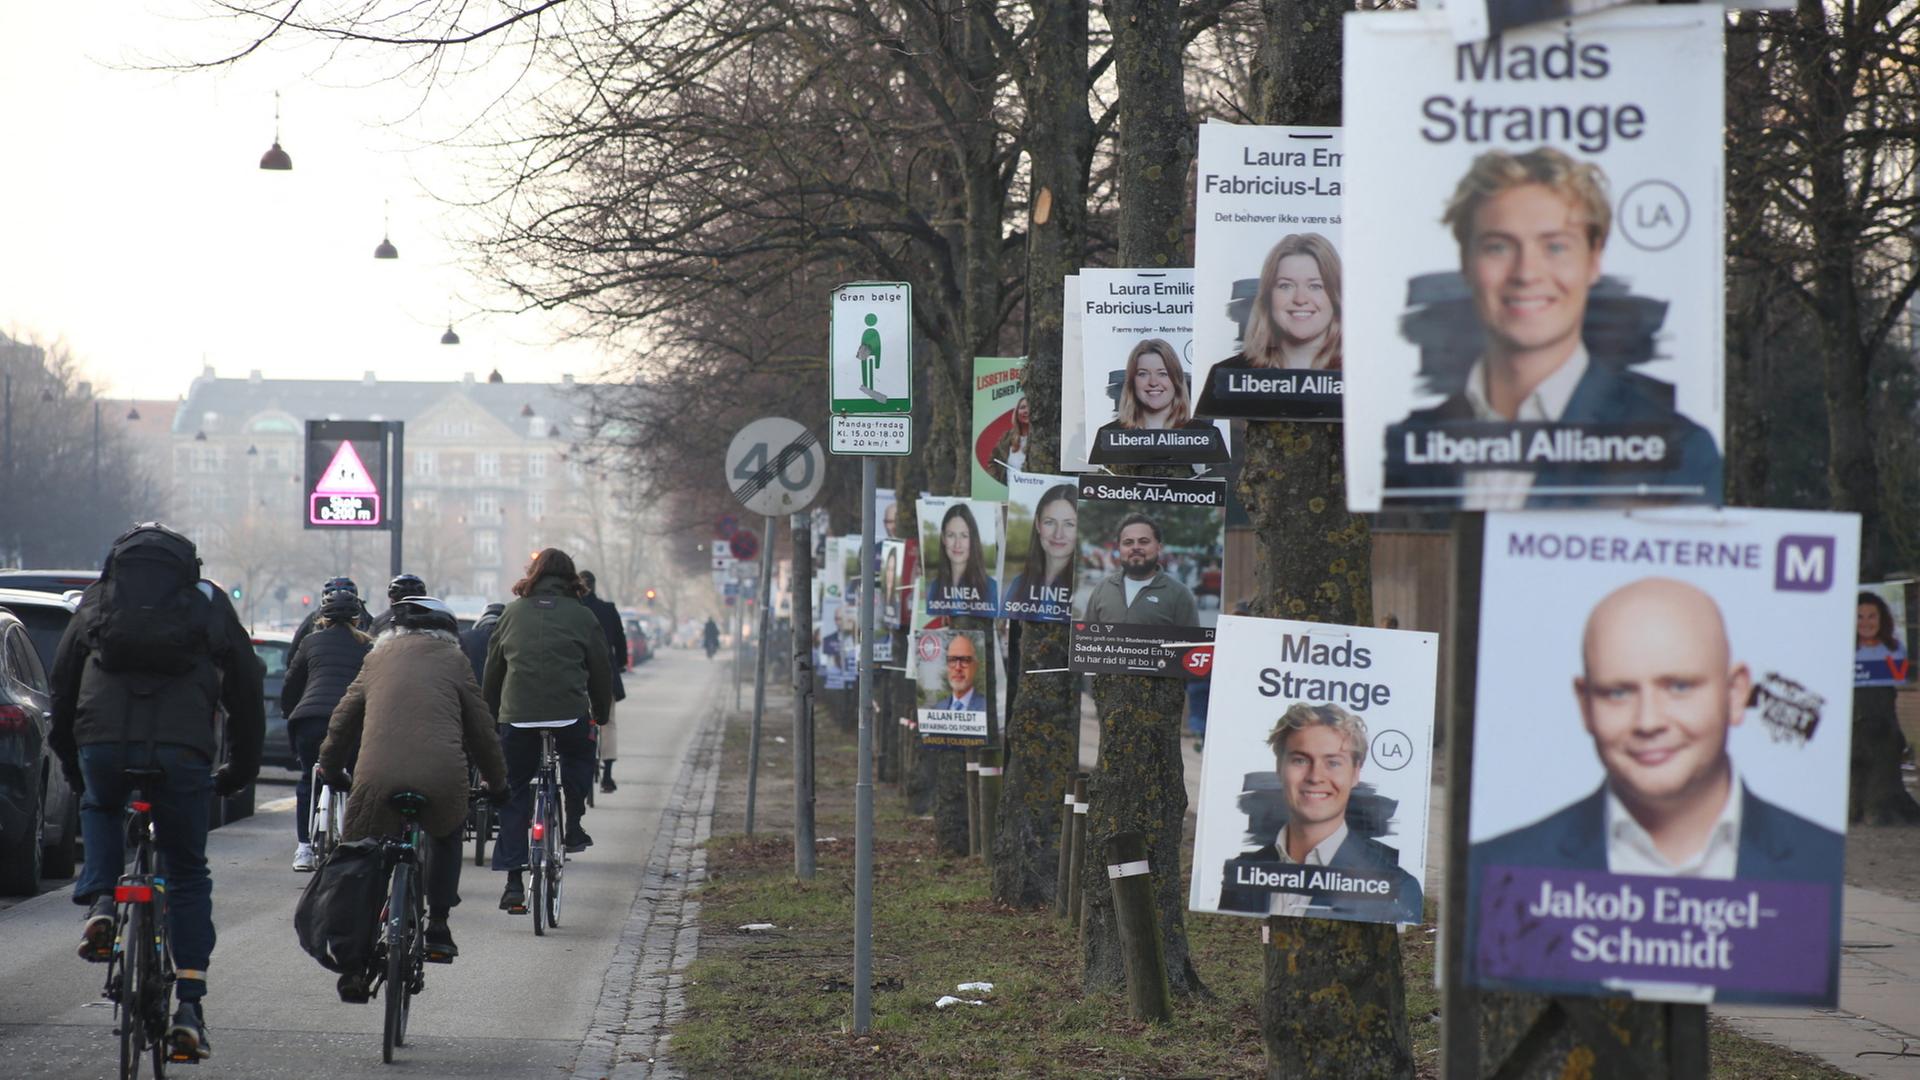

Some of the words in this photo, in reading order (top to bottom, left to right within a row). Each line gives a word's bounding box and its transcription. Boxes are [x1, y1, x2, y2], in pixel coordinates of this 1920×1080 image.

[1455, 38, 1610, 81] Mads
[1420, 95, 1646, 153] Strange
[1244, 147, 1306, 167] Laura
[1205, 174, 1342, 196] Fabricius-La
[1215, 212, 1232, 222] Det
[1234, 213, 1275, 223] behøver
[1278, 213, 1299, 224] ikke
[1301, 216, 1327, 224] være
[1636, 203, 1672, 229] LA
[1110, 282, 1150, 295] Laura
[840, 293, 865, 302] Grøn
[871, 293, 902, 302] bølge
[1086, 301, 1193, 315] Fabricius-Lauri
[1133, 326, 1152, 334] regler
[1228, 374, 1297, 393] Liberal
[1300, 375, 1344, 394] Allia
[838, 420, 904, 429] Mandag-fredag
[851, 430, 905, 438] 15.00-18.00
[1110, 433, 1154, 446] Liberal
[1157, 433, 1209, 446] Alliance
[853, 439, 866, 447] 20
[867, 439, 888, 447] km/t
[1405, 431, 1521, 464] Liberal
[1527, 429, 1666, 463] Alliance
[733, 442, 815, 492] 40
[1014, 475, 1044, 486] Venstre
[1097, 485, 1142, 501] Sadek
[1143, 488, 1216, 505] Al-Amood
[357, 509, 371, 520] m
[1507, 533, 1762, 569] MODERATERNE
[1784, 546, 1826, 583] M
[943, 586, 980, 600] LINEA
[929, 600, 996, 611] SØGAARD-LIDELL
[1004, 601, 1072, 617] SØGAARD-L
[1075, 643, 1102, 653] Sadek
[1104, 645, 1149, 655] Al-Amood
[1280, 633, 1372, 670] Mads
[1074, 655, 1085, 663] du
[1087, 655, 1101, 663] har
[1103, 656, 1117, 664] råd
[1138, 658, 1149, 666] bo
[1189, 653, 1211, 667] SF
[1258, 667, 1391, 712] Strange
[927, 711, 953, 721] ALLAN
[953, 712, 977, 722] FELDT
[1381, 743, 1403, 757] LA
[1236, 866, 1304, 889] Liberal
[1308, 870, 1390, 894] Alliance
[1529, 881, 1645, 923] Jakob
[1652, 887, 1778, 935] Engel-
[1570, 925, 1733, 970] Schmidt
